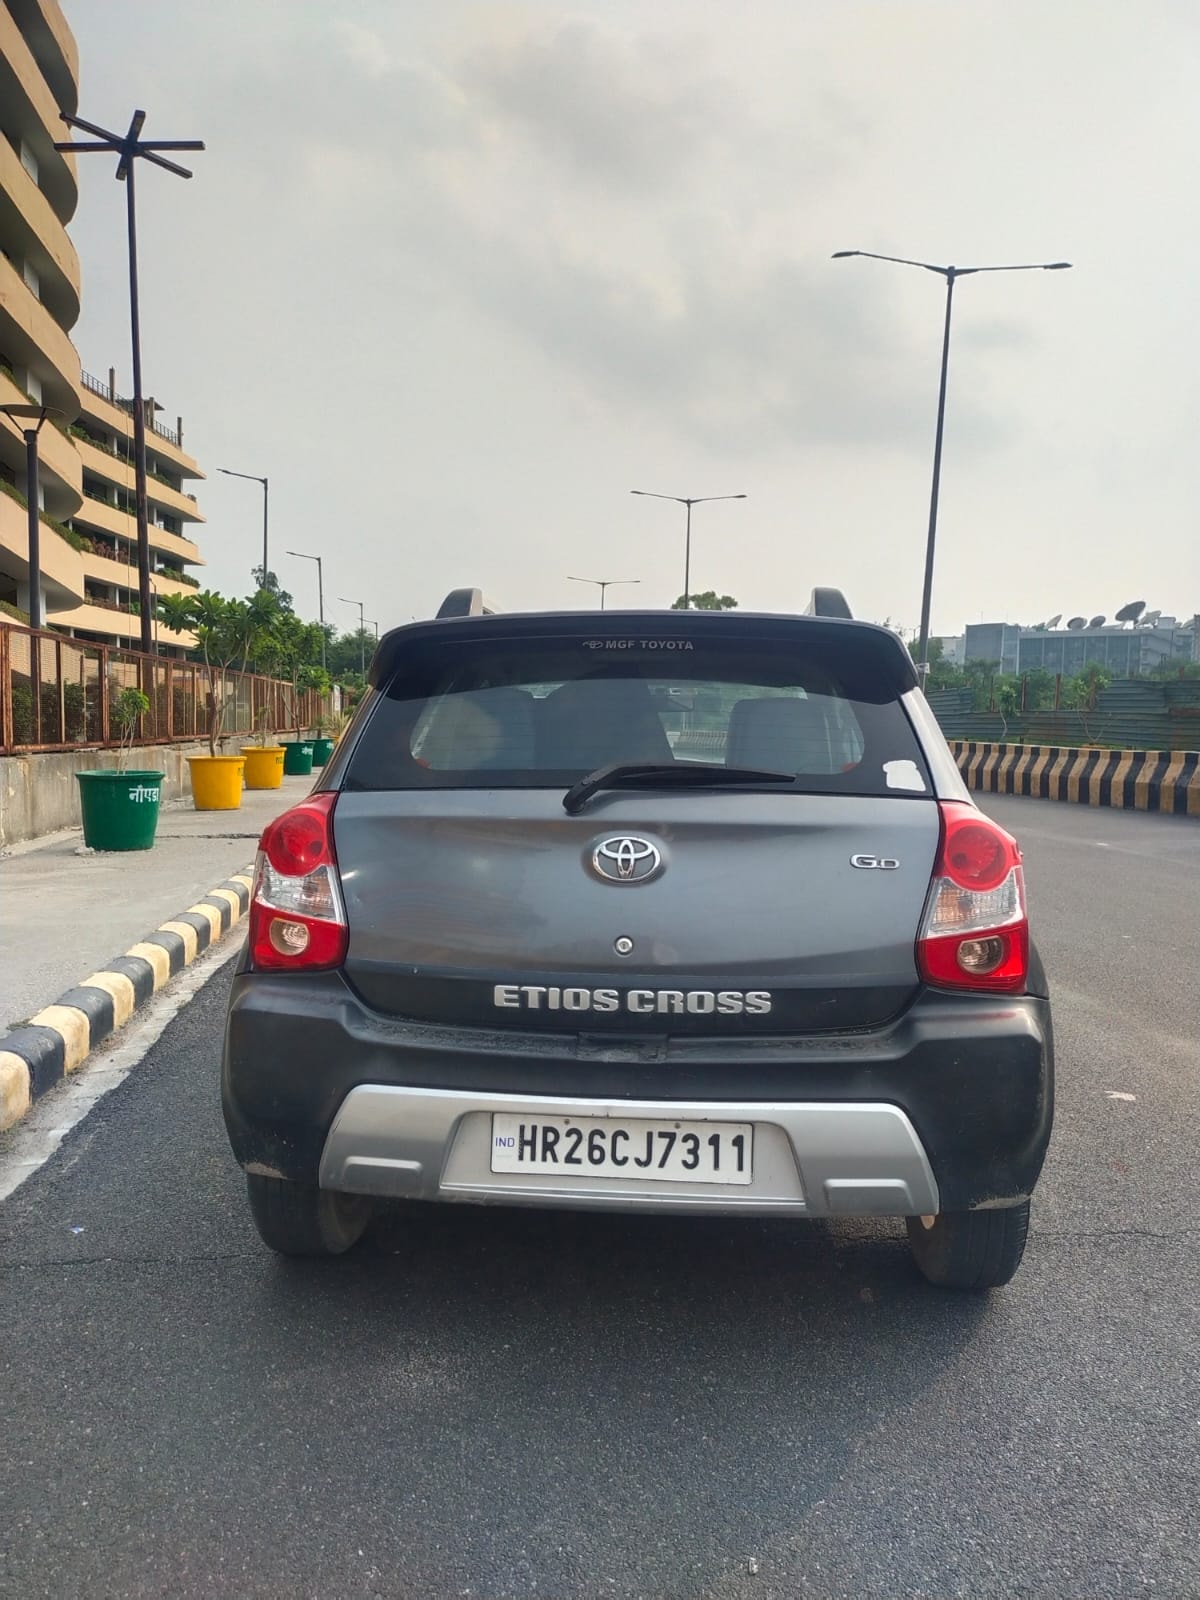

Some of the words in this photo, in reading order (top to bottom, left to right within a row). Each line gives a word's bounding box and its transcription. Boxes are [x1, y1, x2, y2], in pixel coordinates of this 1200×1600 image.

[605, 640, 636, 649] MGF
[639, 640, 694, 650] TOYOTA
[493, 984, 620, 1012] ETIOS
[627, 990, 772, 1014] CROSS
[495, 1136, 515, 1148] IND
[518, 1124, 745, 1172] HR26CJ7311
